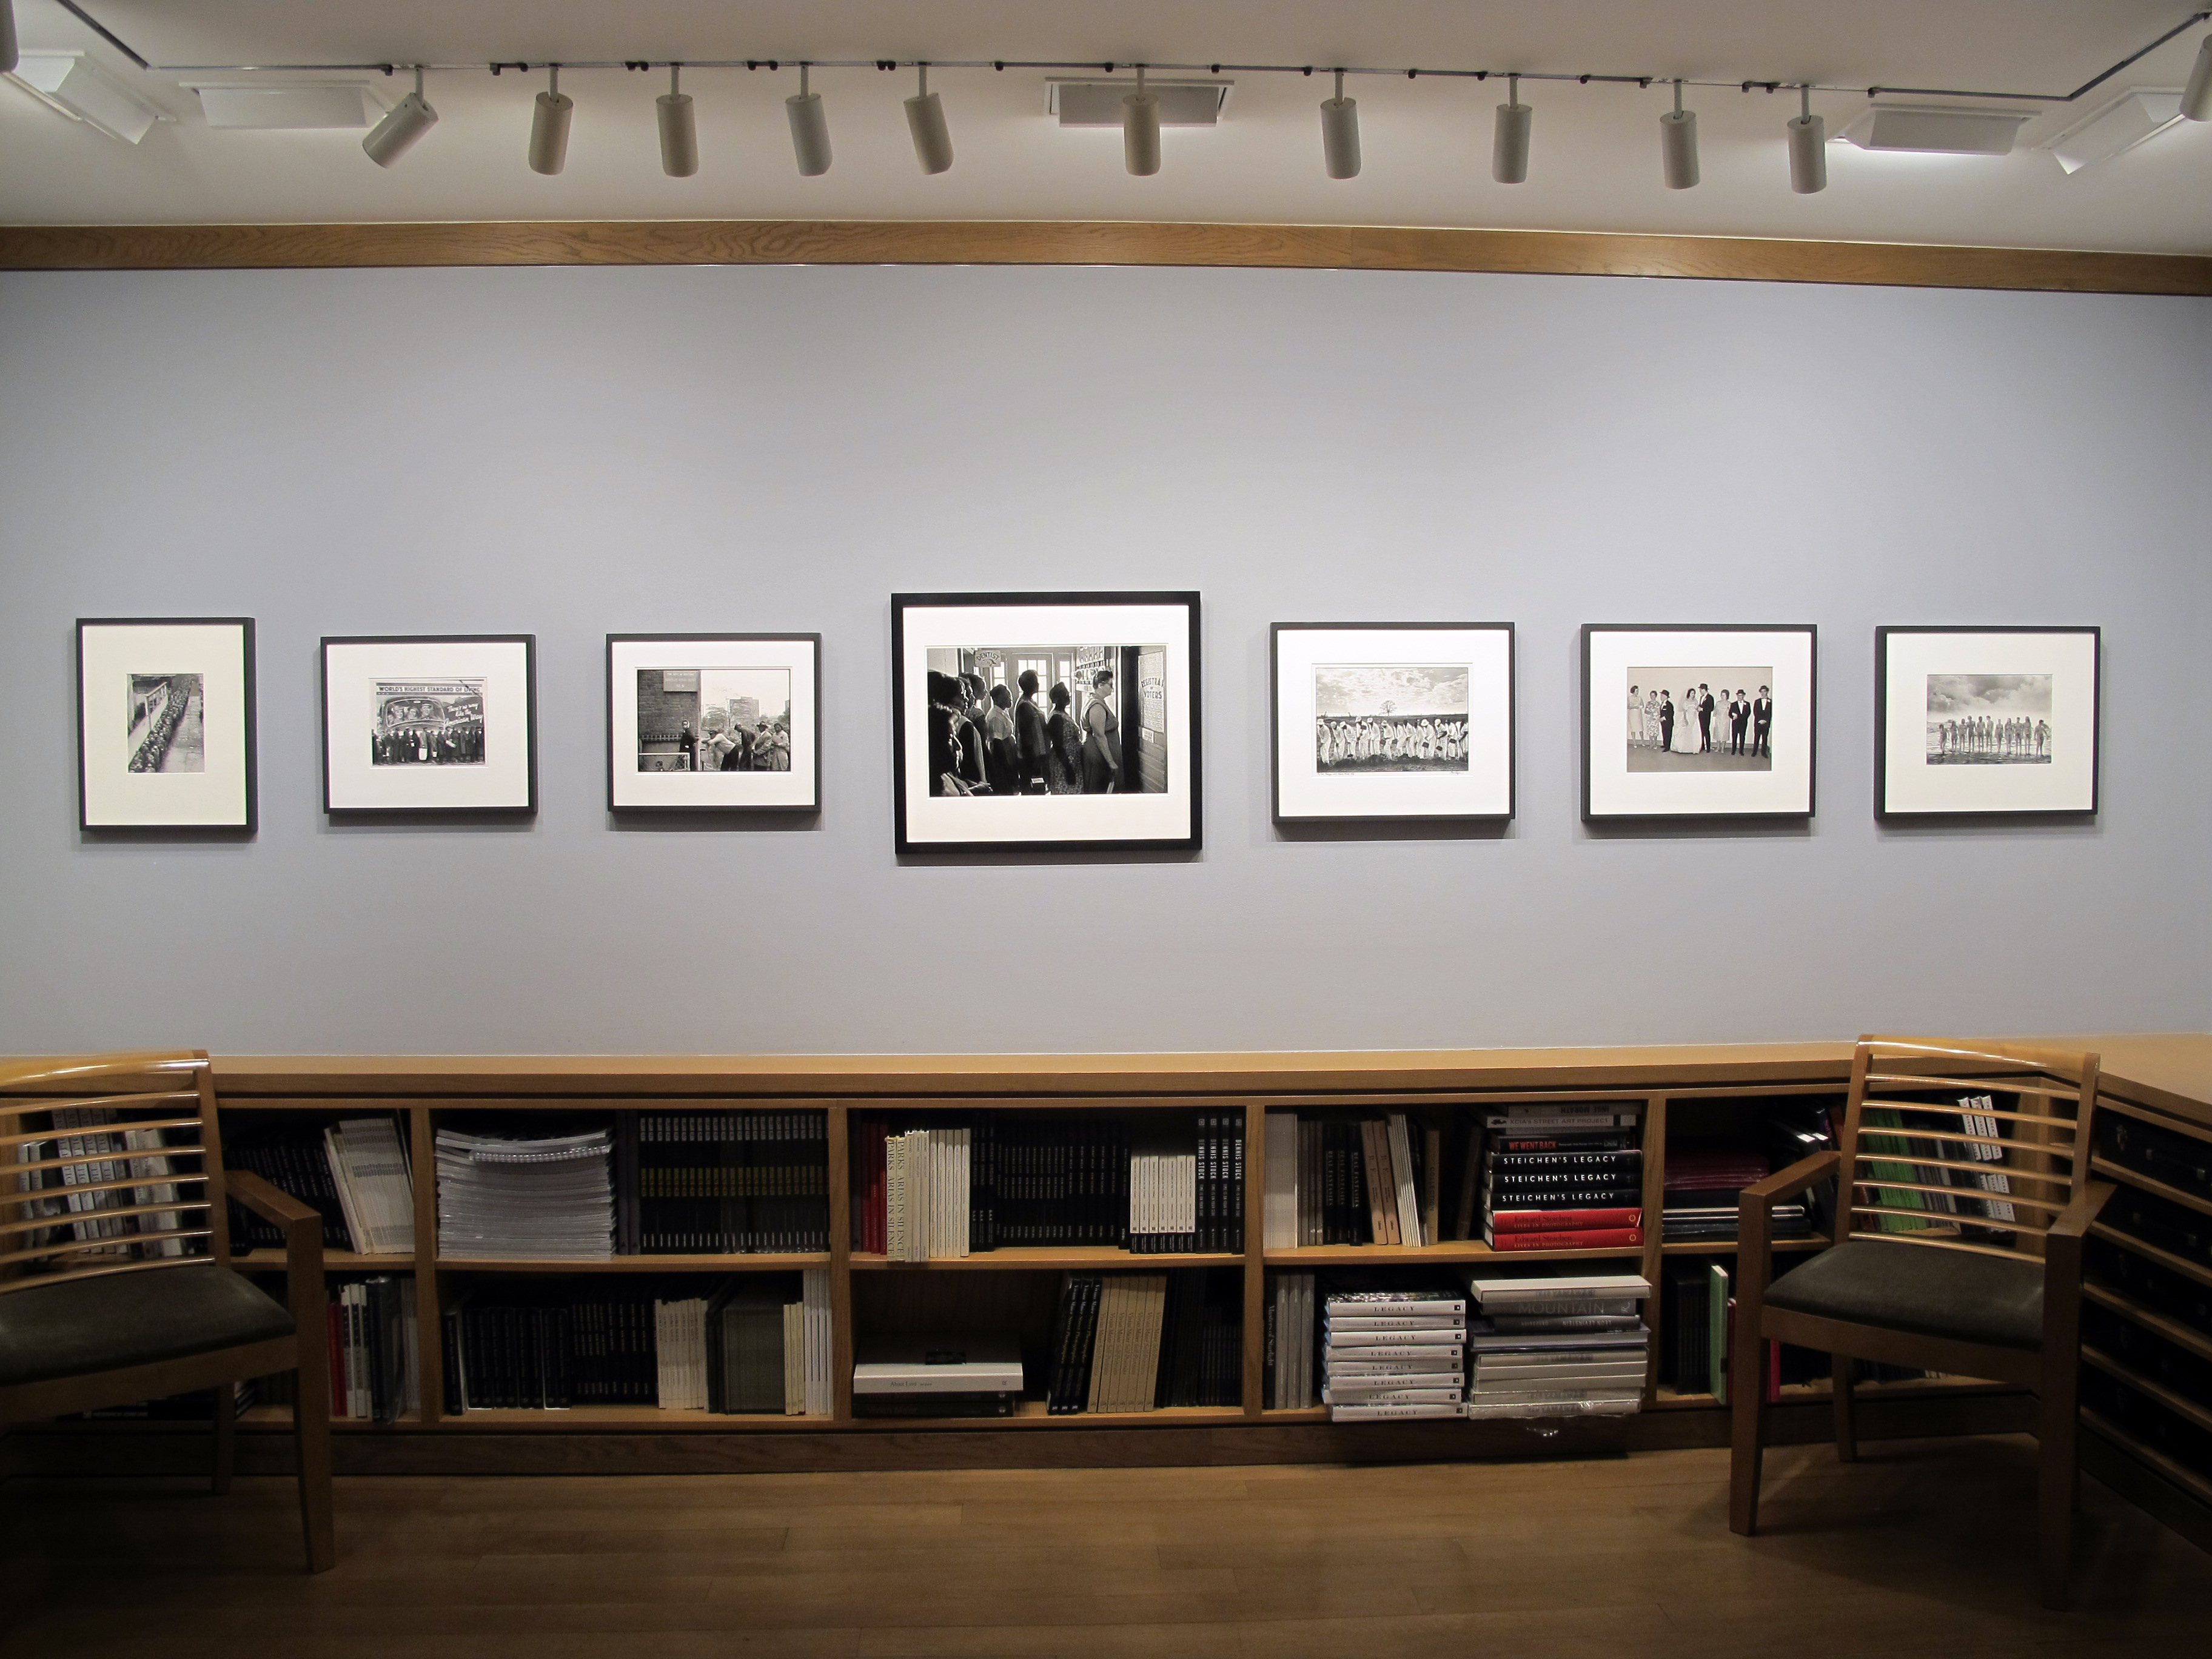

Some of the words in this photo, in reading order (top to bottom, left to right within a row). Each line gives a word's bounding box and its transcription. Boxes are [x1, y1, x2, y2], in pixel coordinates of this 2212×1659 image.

[976, 652, 1000, 660] DENTIST
[1144, 690, 1162, 699] VOTERS
[1503, 1193, 1566, 1202] STEICHEN'S
[888, 1205, 894, 1215] IN
[897, 1204, 904, 1213] IN
[1518, 1302, 1604, 1314] MOUNTAIN
[1061, 1331, 1071, 1364] Photographer
[1071, 1331, 1081, 1364] Photographer
[1081, 1331, 1092, 1364] Photographer
